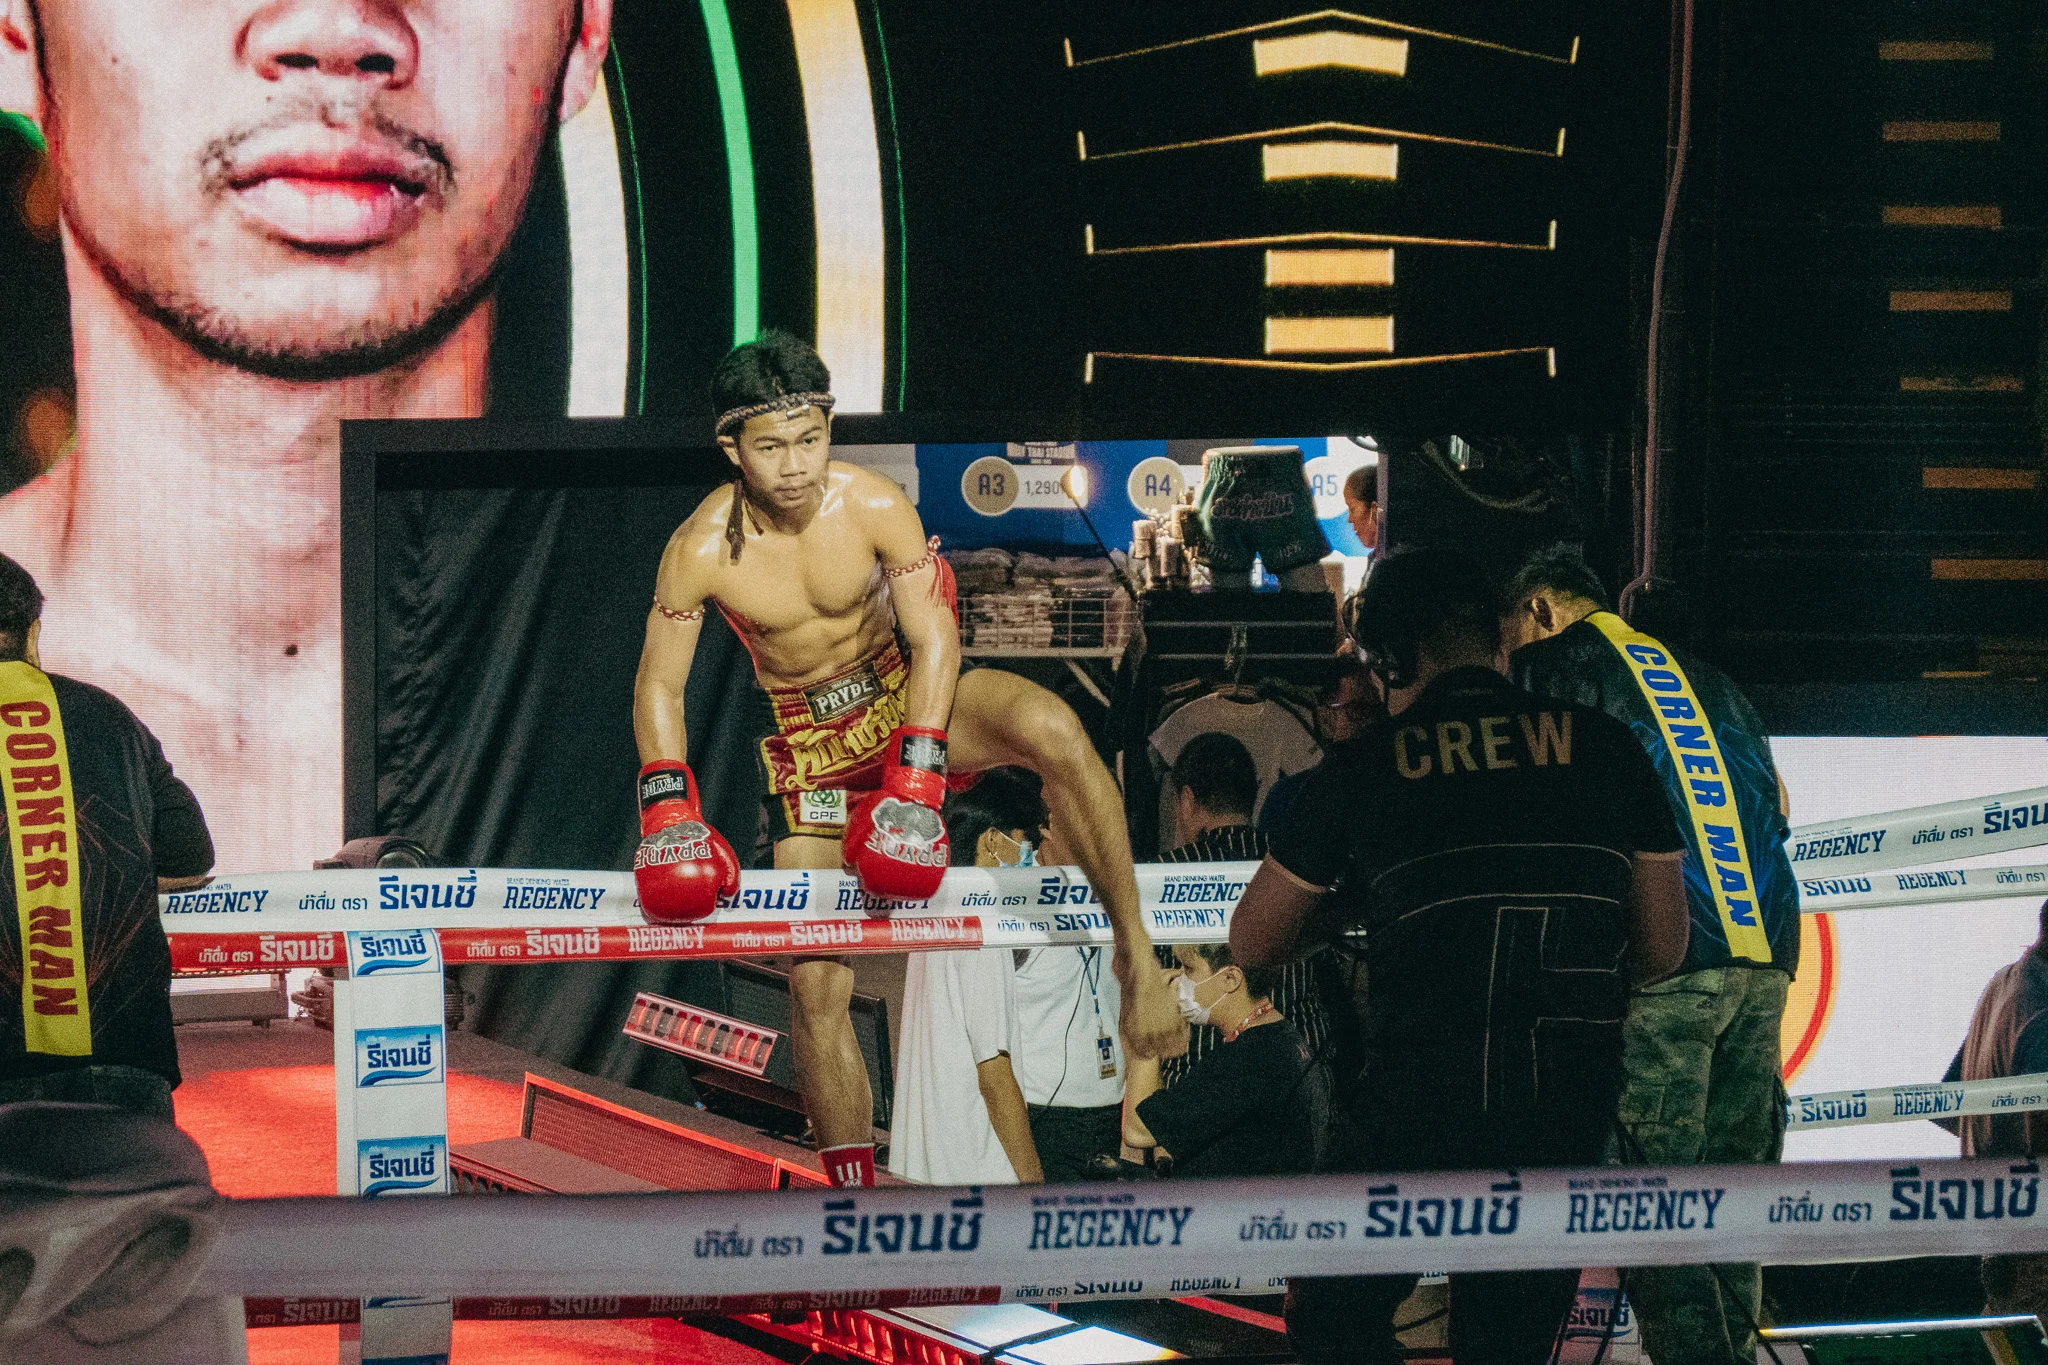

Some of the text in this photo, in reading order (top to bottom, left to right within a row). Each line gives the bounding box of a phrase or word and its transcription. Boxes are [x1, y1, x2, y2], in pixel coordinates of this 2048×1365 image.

[979, 473, 1004, 495] A3
[1025, 480, 1059, 496] 1,290
[1145, 474, 1172, 496] A4
[1312, 474, 1338, 496] A5
[816, 678, 874, 715] PRYDE
[1395, 711, 1572, 779] CREW
[1624, 644, 1757, 927] CORNER MAN
[810, 811, 839, 820] CPF
[0, 700, 79, 1015] CORNER MAN
[634, 841, 712, 870] PRYDE
[1792, 830, 1886, 861] REGENCY
[164, 890, 268, 914] REGENCY
[342, 897, 368, 910] ตรา
[503, 886, 606, 910] REGENCY
[1001, 895, 1028, 906] ตรา
[1159, 883, 1250, 903] REGENC
[889, 917, 965, 942] REGENCY
[1152, 908, 1226, 928] REGENCY
[627, 926, 705, 952] REGENCY
[1893, 1090, 1965, 1116] REGENCY
[1566, 1188, 1725, 1233] REGENCY
[1833, 1202, 1873, 1222] ตรา
[1028, 1207, 1193, 1250] REGENCY
[1305, 1219, 1347, 1241] ตรา
[762, 1236, 804, 1257] ตรา
